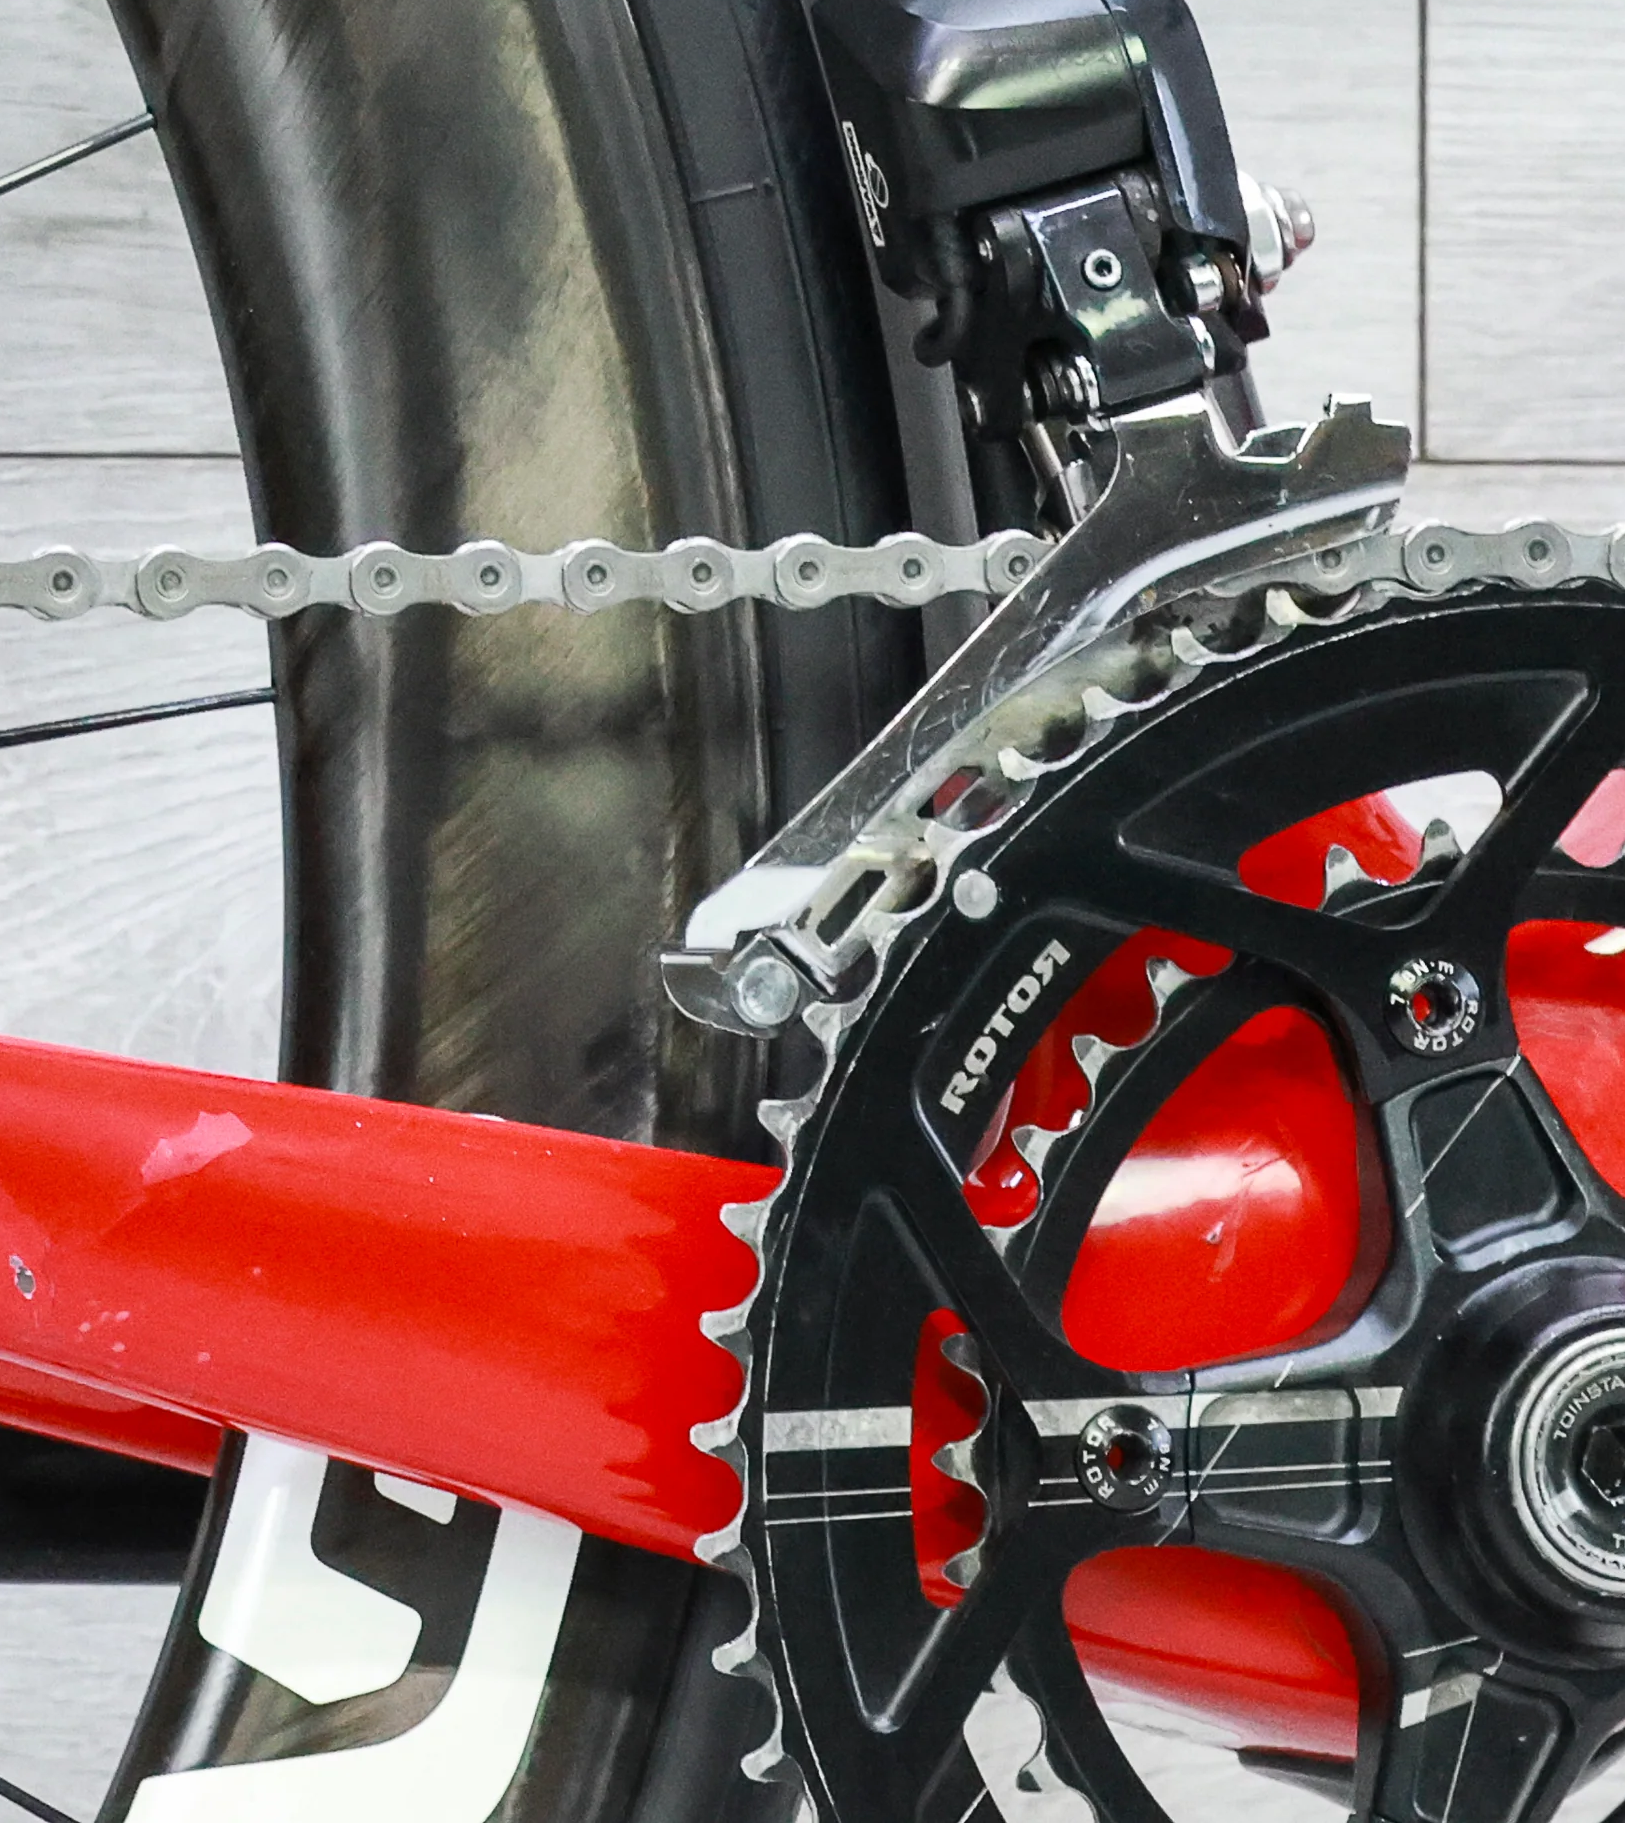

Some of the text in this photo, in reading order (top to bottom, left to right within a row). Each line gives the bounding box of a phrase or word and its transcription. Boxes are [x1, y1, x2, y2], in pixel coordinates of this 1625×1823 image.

[939, 938, 1071, 1115] ROTOR
[1414, 1000, 1478, 1051] ROTOR
[1082, 1415, 1116, 1499] ROTOR
